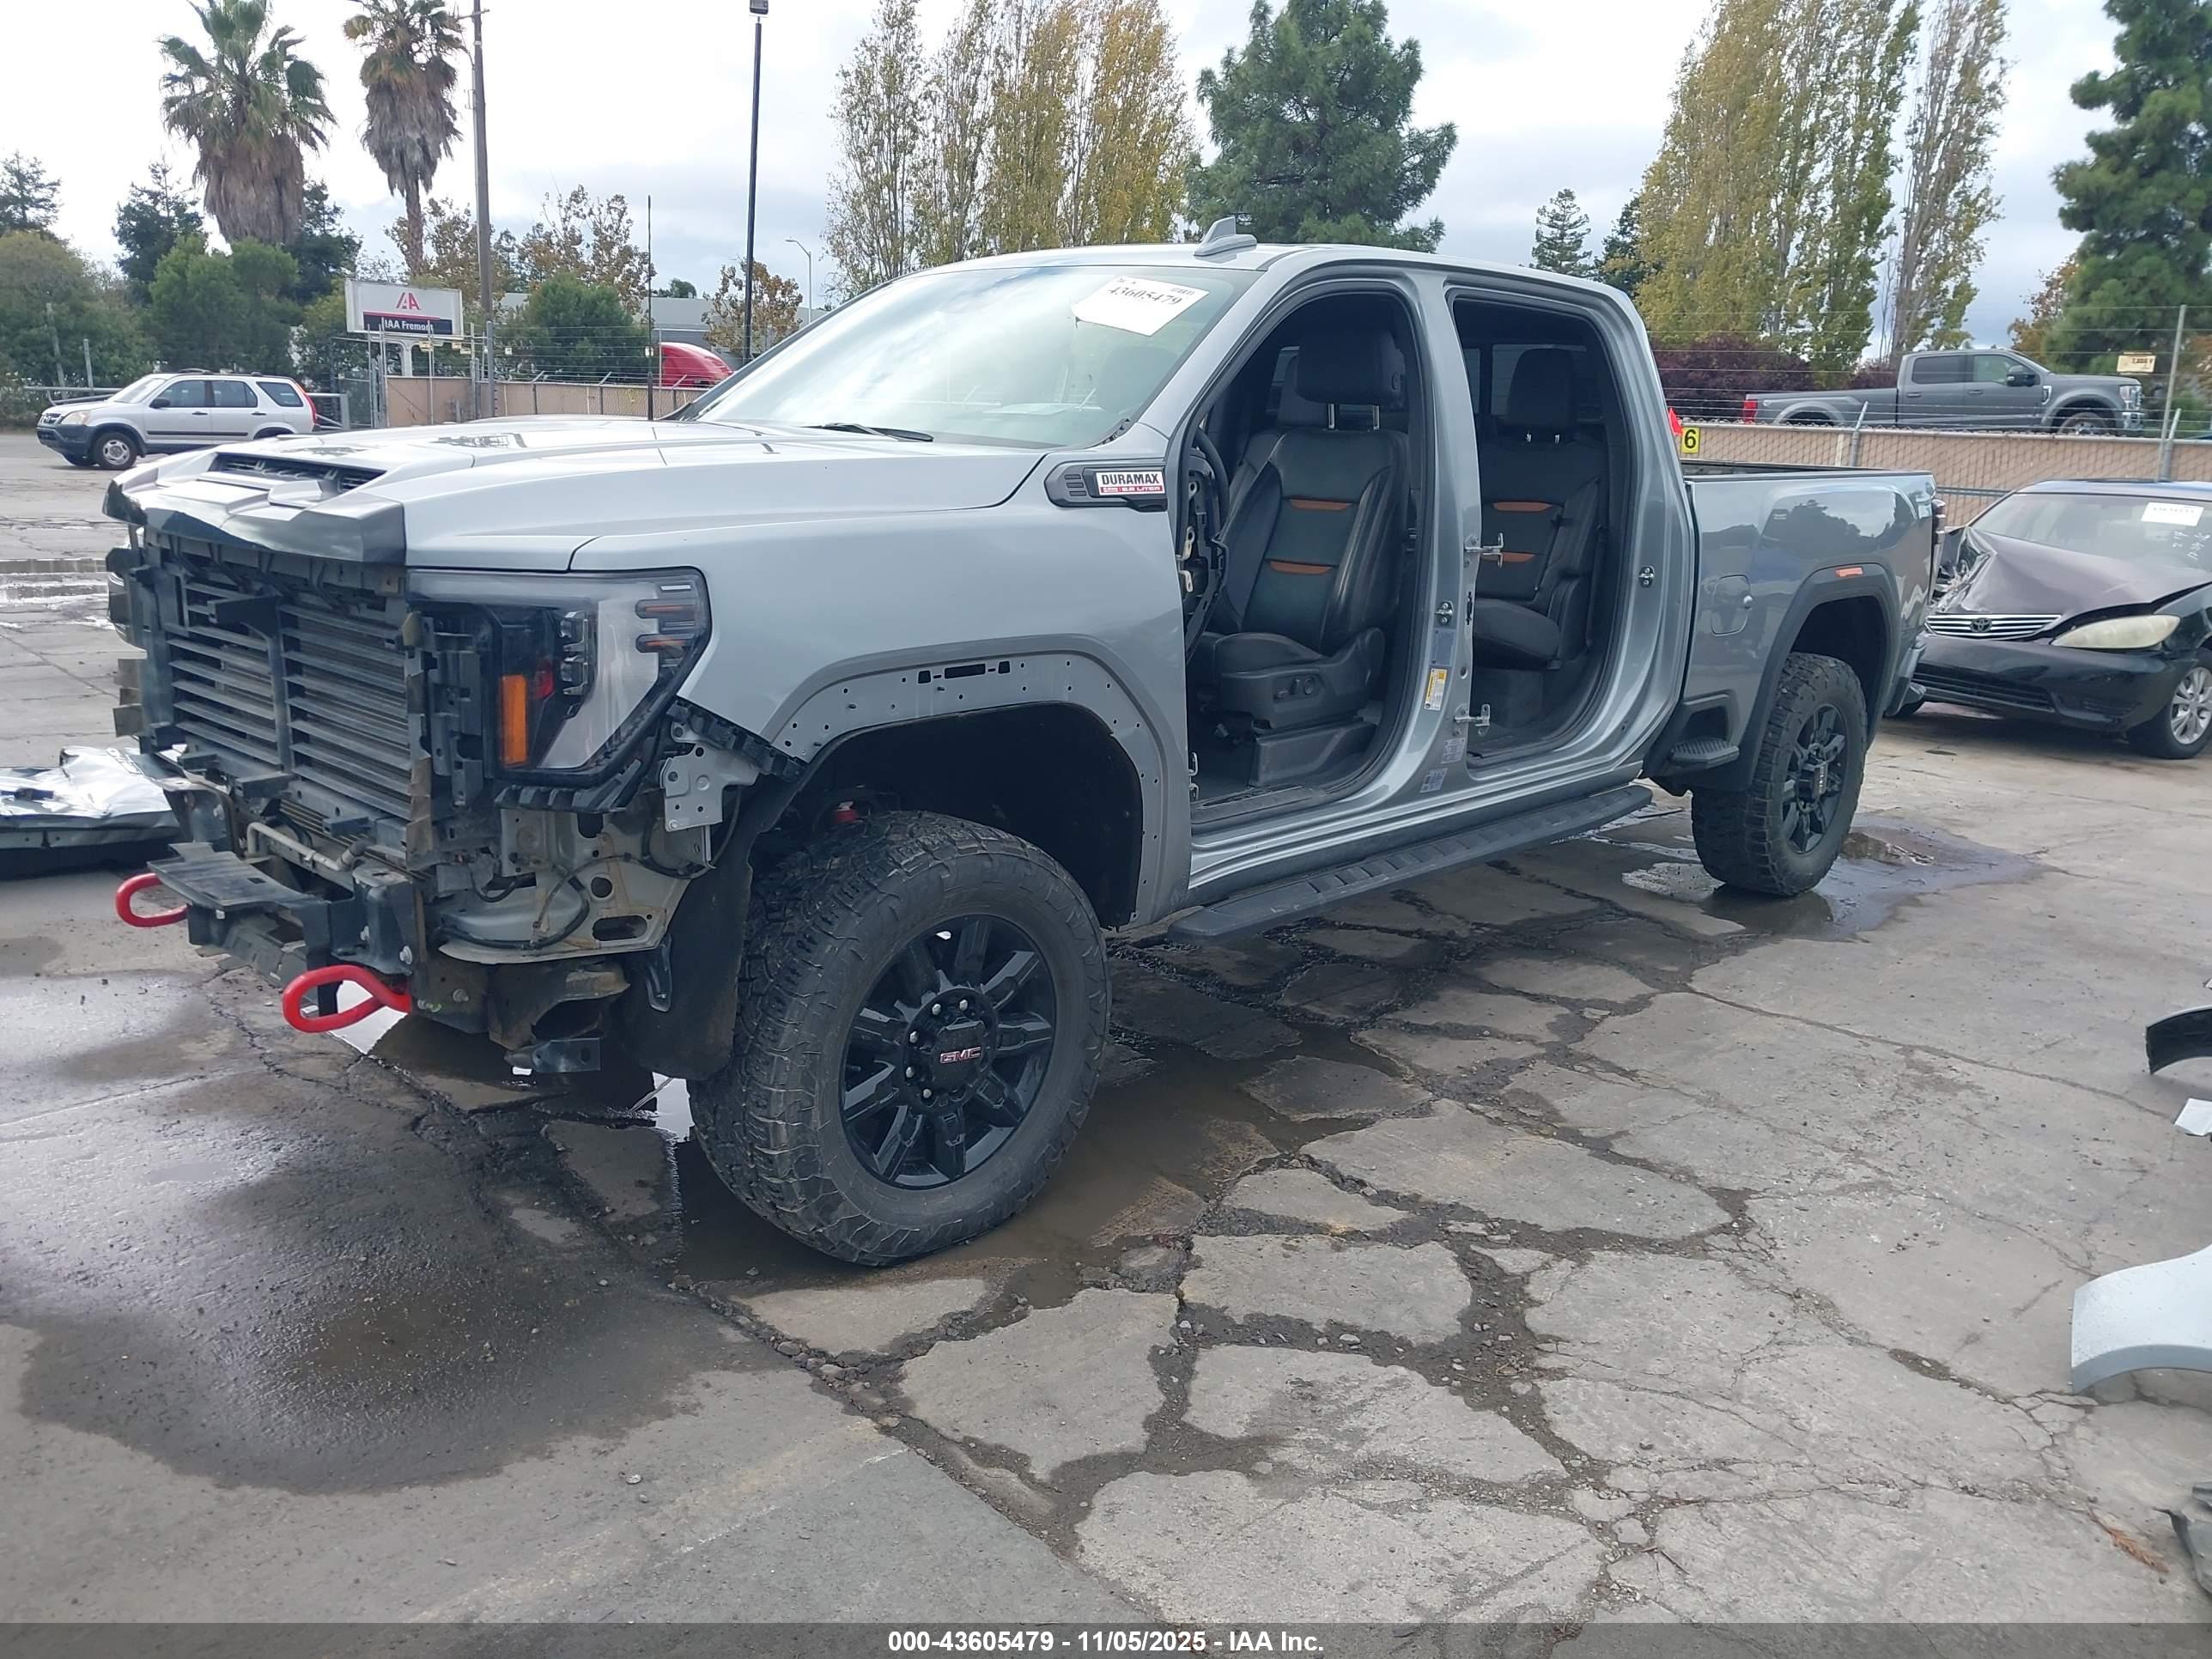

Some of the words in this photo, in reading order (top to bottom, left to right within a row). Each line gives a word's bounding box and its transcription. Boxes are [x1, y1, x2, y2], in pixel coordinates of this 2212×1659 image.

[1108, 286, 1182, 304] 43605479
[385, 319, 400, 329] IAA
[1684, 428, 1697, 449] 6
[1101, 473, 1160, 485] DURAMAX
[939, 1046, 981, 1064] GMC
